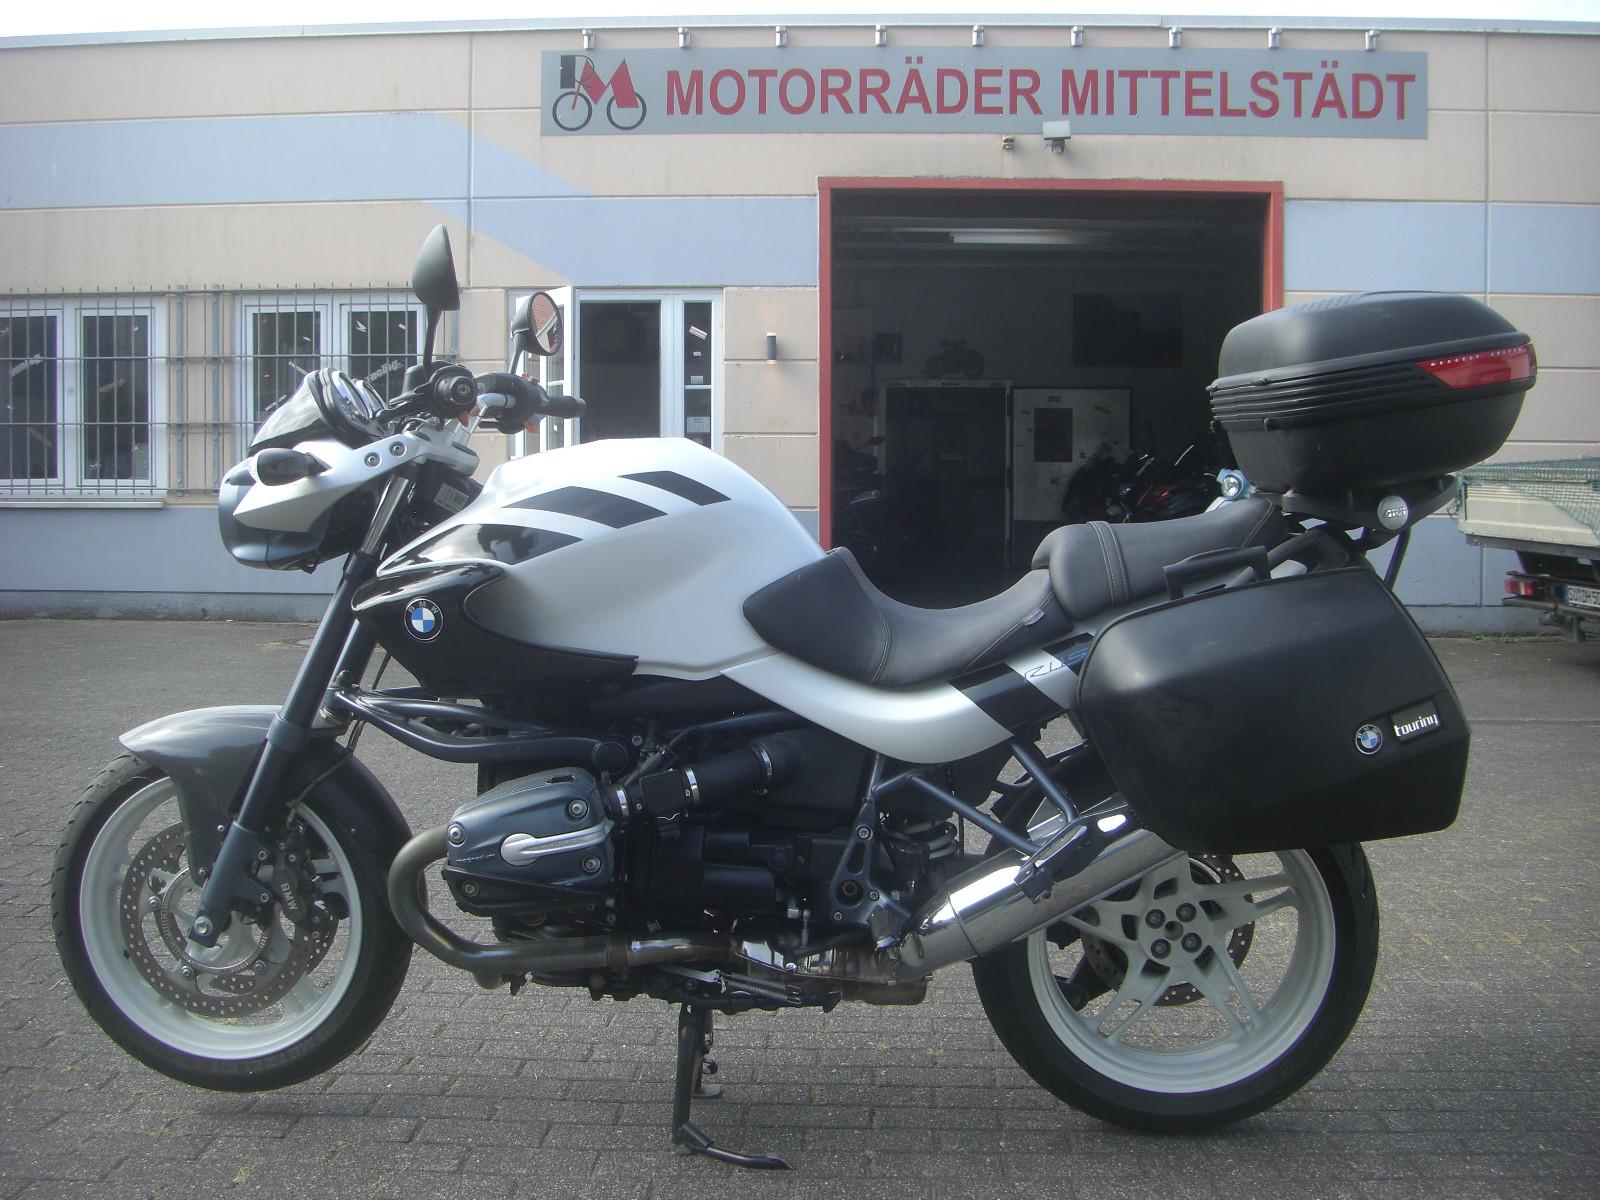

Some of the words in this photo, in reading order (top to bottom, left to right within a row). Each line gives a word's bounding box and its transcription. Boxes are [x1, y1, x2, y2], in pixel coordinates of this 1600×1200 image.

[667, 56, 1042, 115] MOTORRÄDER
[1061, 60, 1416, 120] MITTELSTÄDT
[408, 600, 439, 614] BMW
[280, 882, 298, 910] BMW
